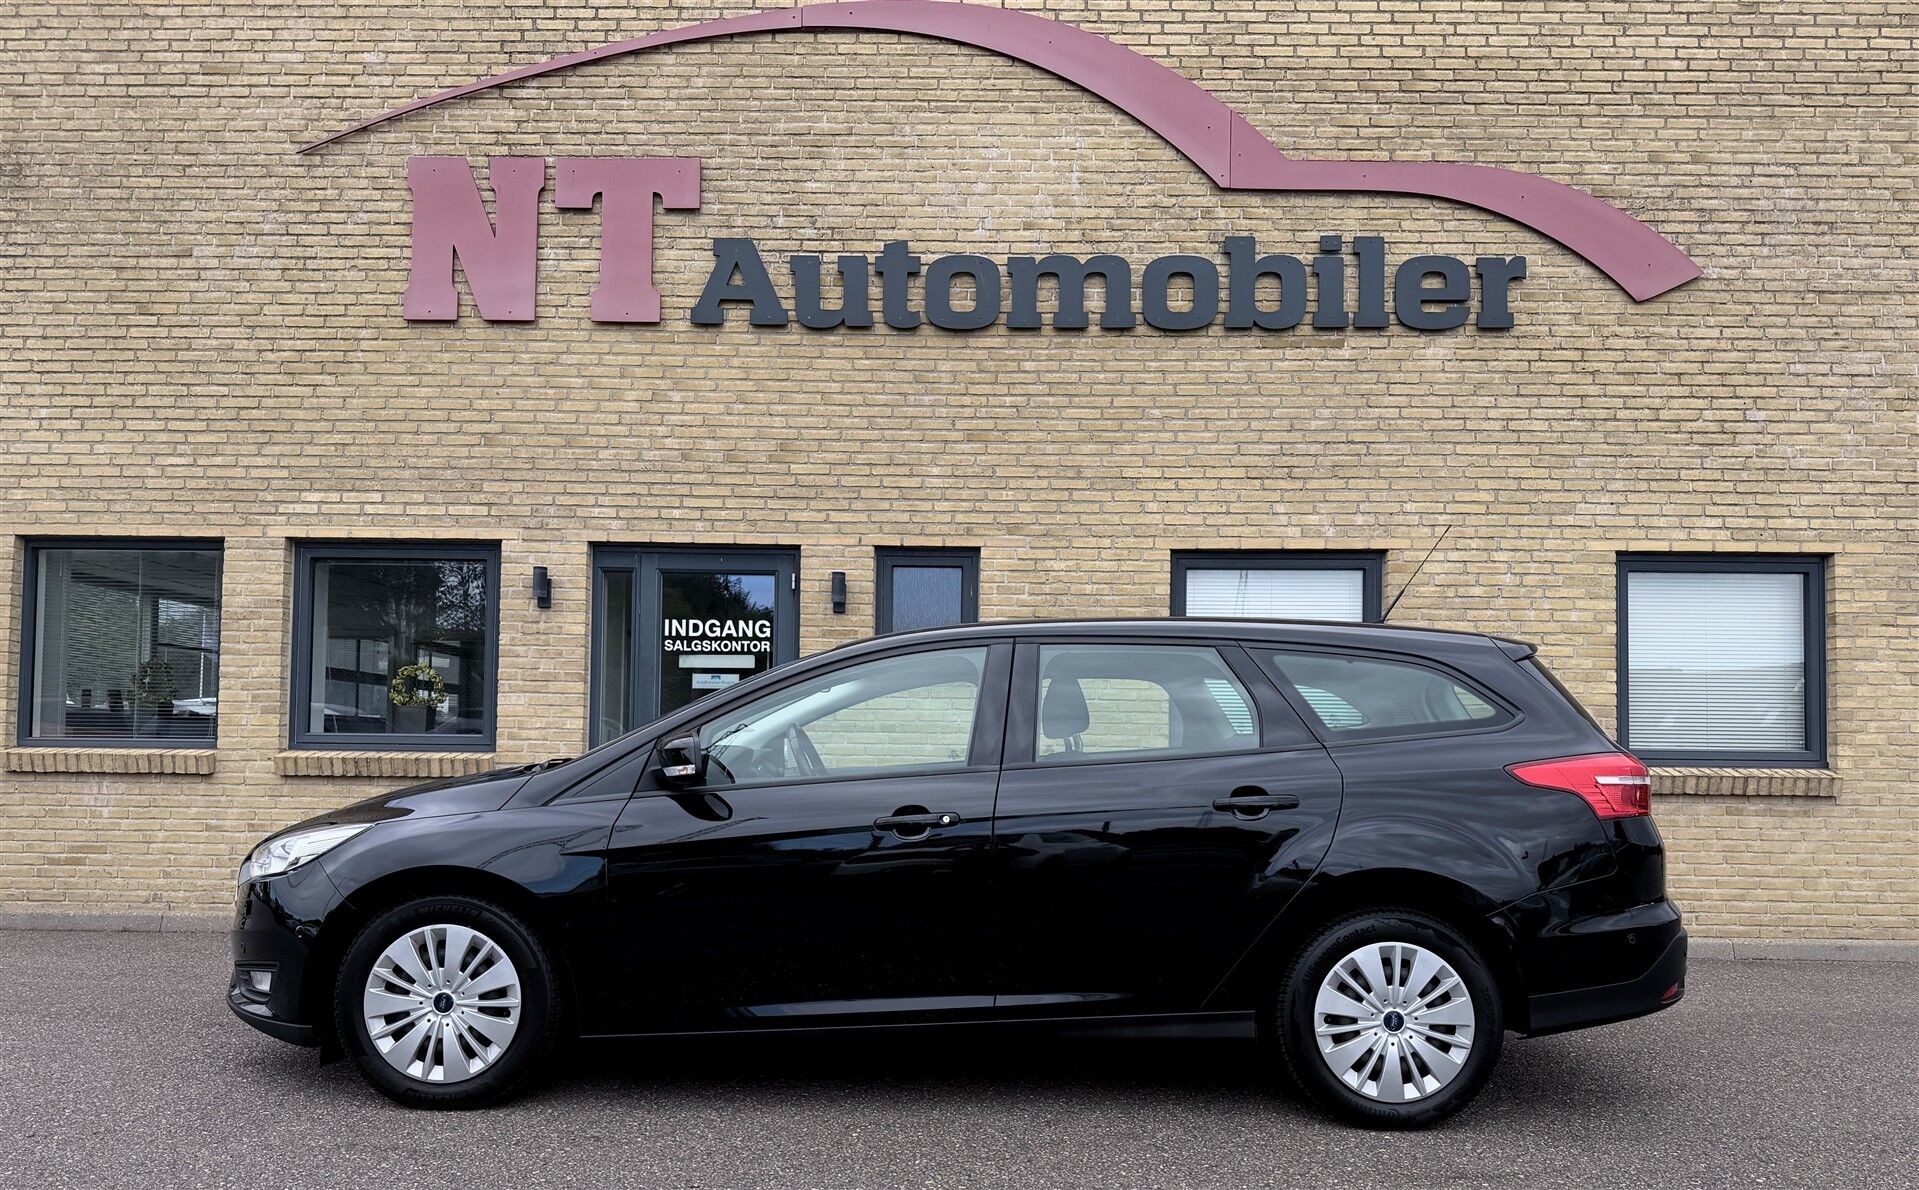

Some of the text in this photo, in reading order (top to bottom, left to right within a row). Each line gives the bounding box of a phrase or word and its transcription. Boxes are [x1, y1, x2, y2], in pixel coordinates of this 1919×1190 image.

[403, 157, 1527, 331] NT Automobiler
[664, 618, 771, 638] INDGANG
[664, 640, 771, 652] SALGSKONTOR
